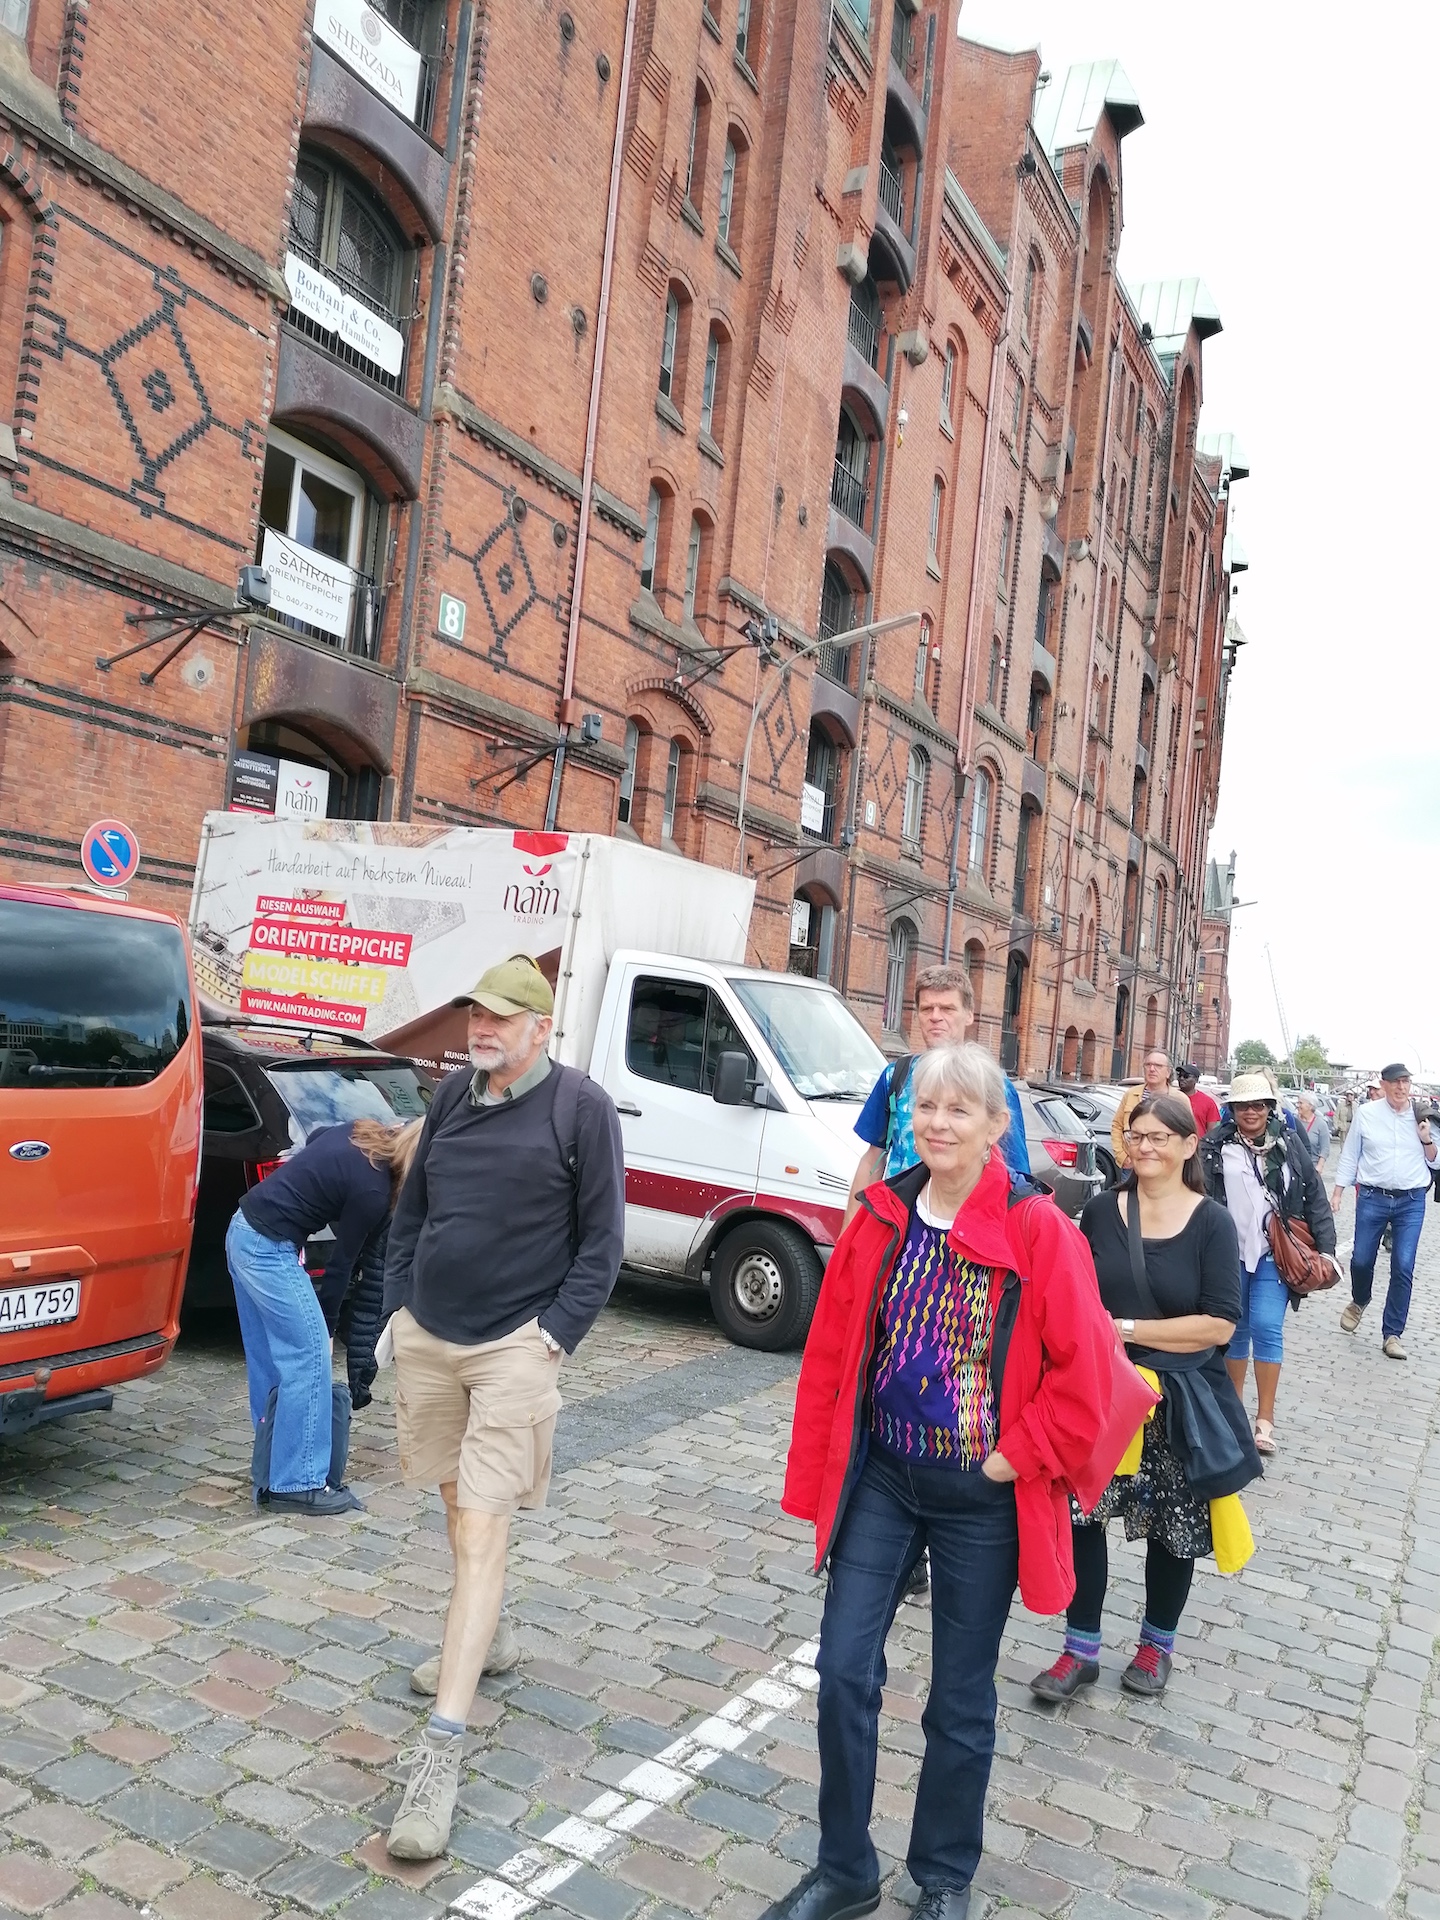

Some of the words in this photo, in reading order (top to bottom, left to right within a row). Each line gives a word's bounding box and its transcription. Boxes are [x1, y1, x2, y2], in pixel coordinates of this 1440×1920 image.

[327, 14, 404, 99] SHERZADA
[294, 286, 321, 314] Brock
[324, 307, 330, 319] 7
[340, 319, 381, 357] Hamburg
[296, 267, 345, 315] Borhani
[349, 308, 360, 325] &
[364, 318, 381, 342] Co.
[268, 564, 344, 604] ORIENTTEPPICHE
[279, 551, 336, 588] SAHRAI
[286, 594, 313, 612] 040/37
[315, 607, 324, 617] 42
[325, 612, 339, 623] 777
[445, 600, 460, 634] 8
[285, 790, 318, 813] nain
[867, 803, 874, 823] 9
[267, 848, 333, 879] Handarbeit
[335, 856, 360, 881] auf
[362, 855, 418, 885] höchstem
[420, 860, 474, 889] Niveau!
[259, 899, 293, 913] RIESEN
[293, 902, 341, 918] AUSWAHL
[503, 880, 560, 916] nain
[513, 915, 545, 925] TRADING
[254, 925, 406, 960] ORIENTTEPPICHE
[249, 962, 382, 996] MODELSCHIFFE
[247, 997, 362, 1025] WWW.NAINTRADING.COM
[20, 1144, 44, 1157] Ford
[0, 1294, 27, 1321] AA
[35, 1287, 75, 1317] 759
